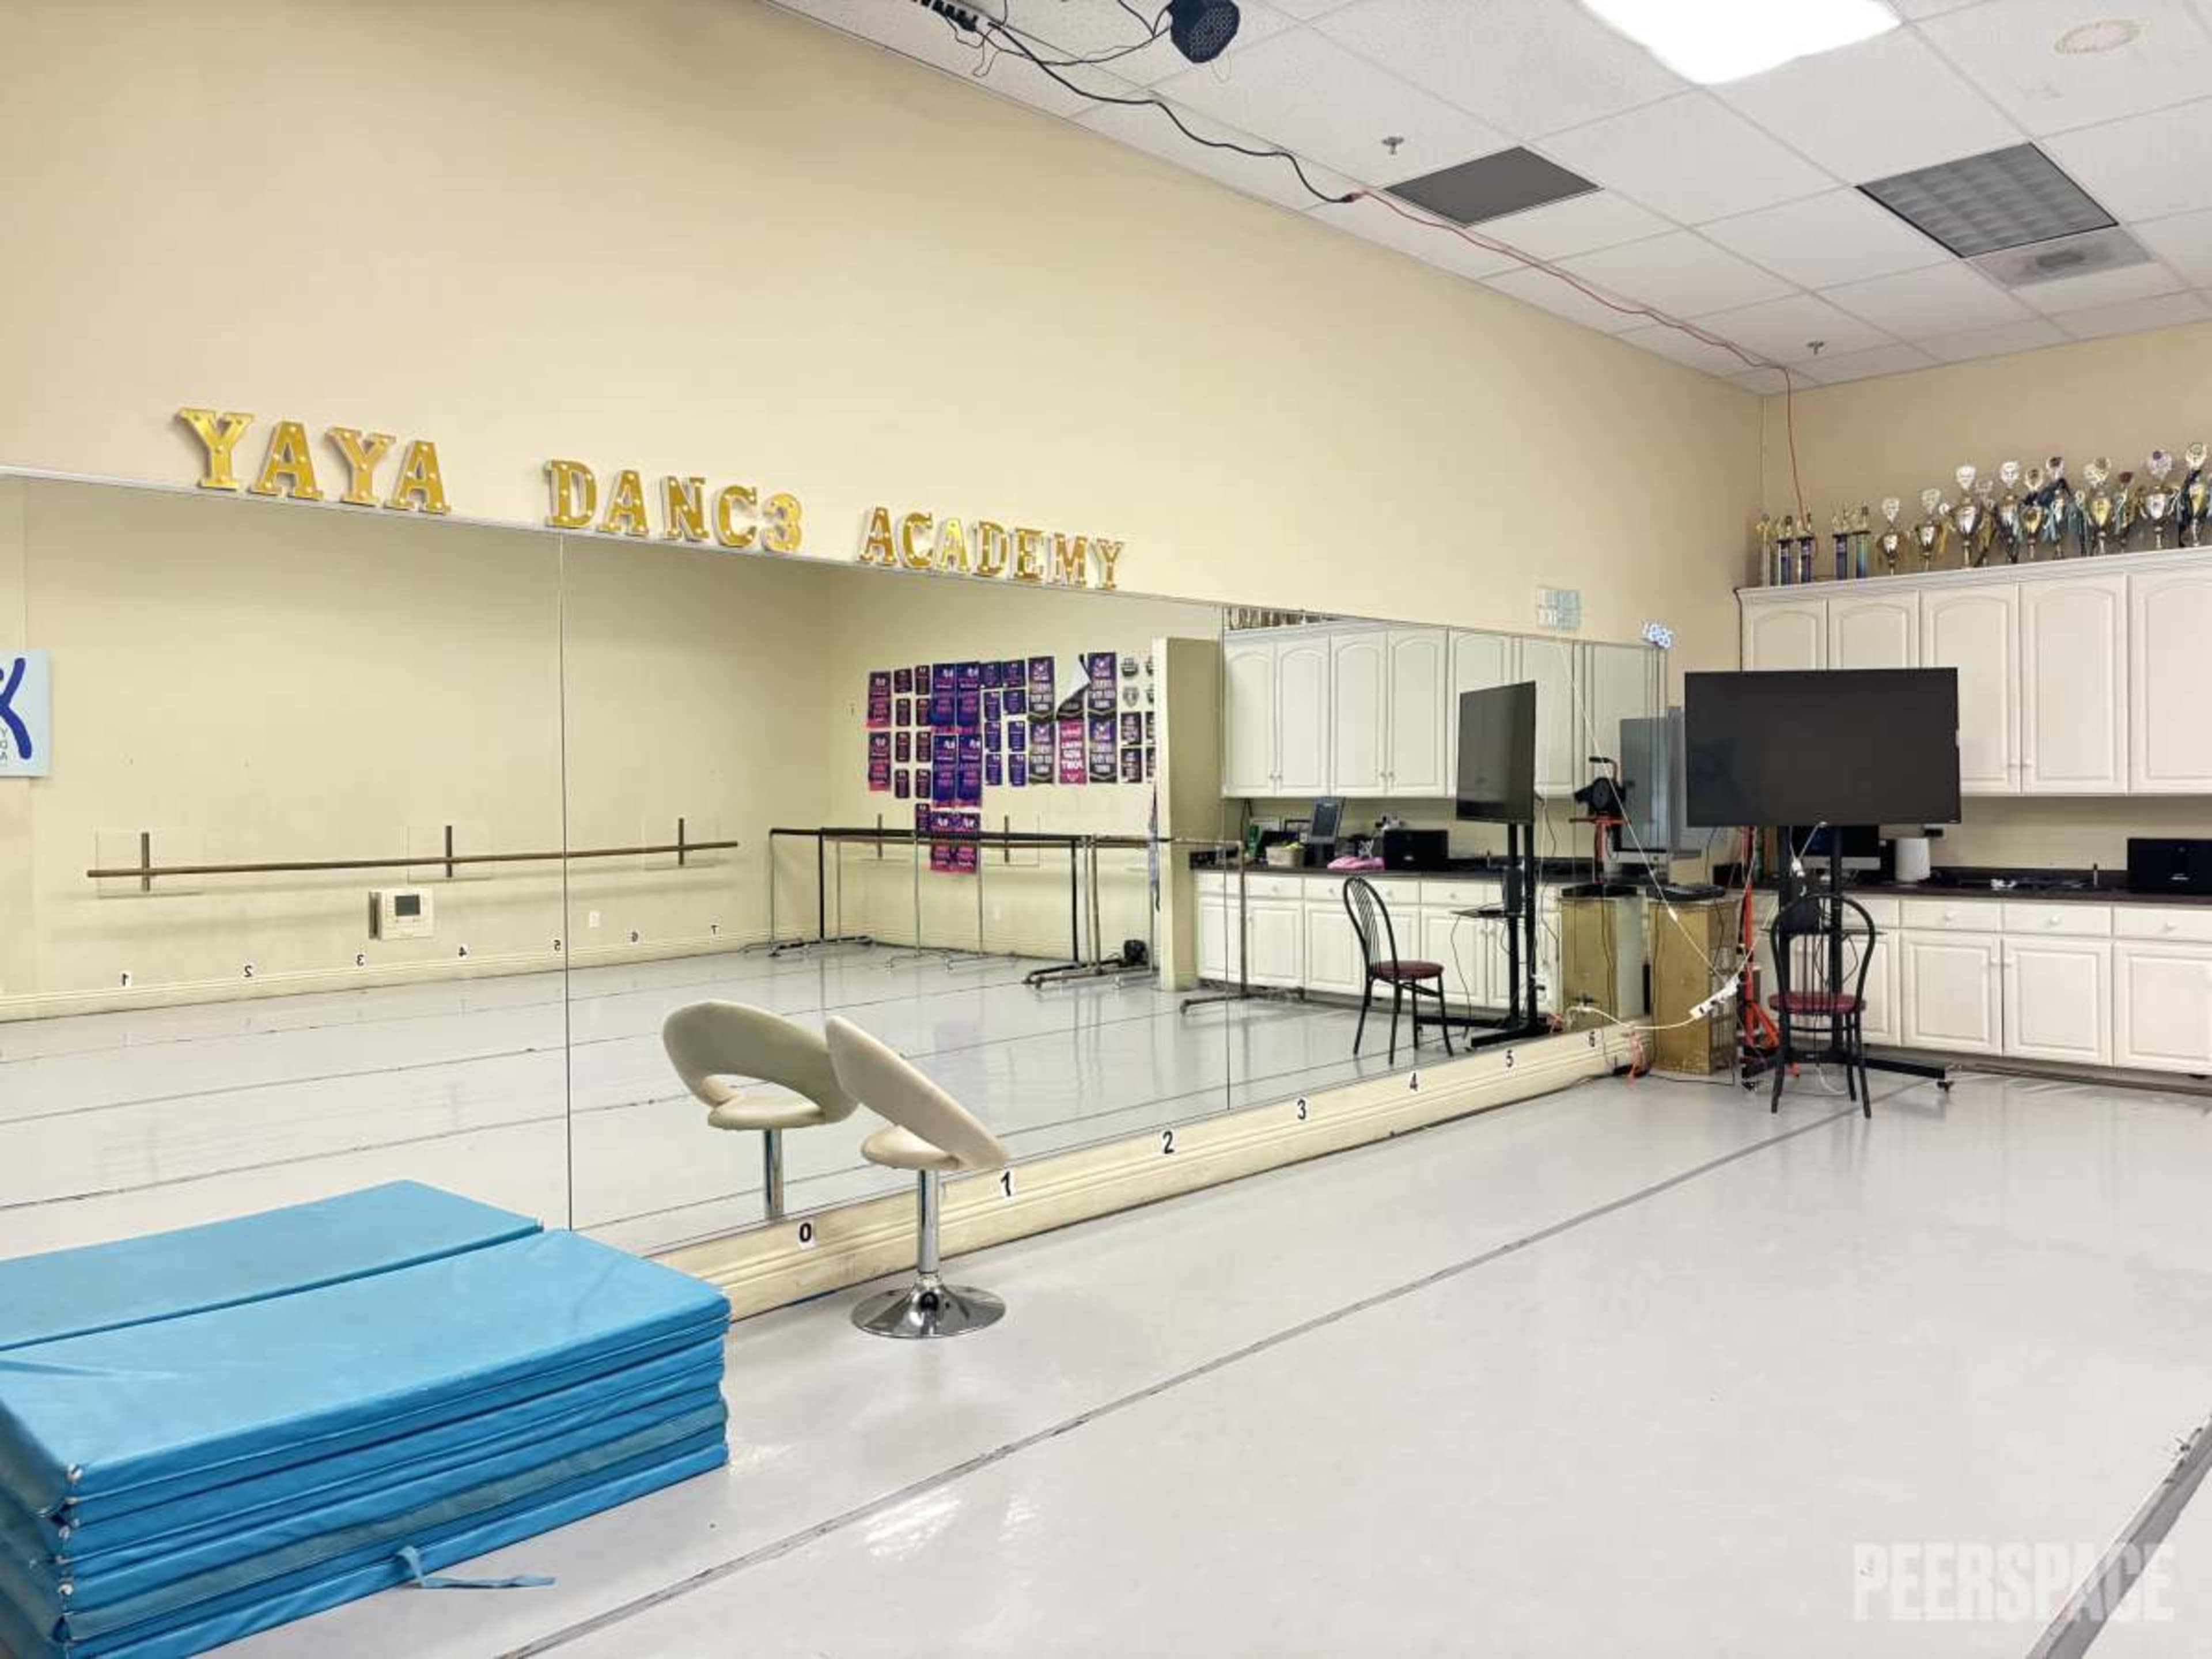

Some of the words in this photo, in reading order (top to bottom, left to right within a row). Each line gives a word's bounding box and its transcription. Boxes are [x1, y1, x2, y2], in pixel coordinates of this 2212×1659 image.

[176, 408, 452, 515] YAYA
[545, 459, 803, 553] DANC3
[858, 506, 1123, 591] ACADEMY
[1506, 1049, 1514, 1067] 5
[1409, 1072, 1418, 1091] 4
[1297, 1099, 1307, 1120] 3
[1162, 1131, 1175, 1154] 2
[1000, 1171, 1012, 1196] 1
[799, 1222, 812, 1243] 0
